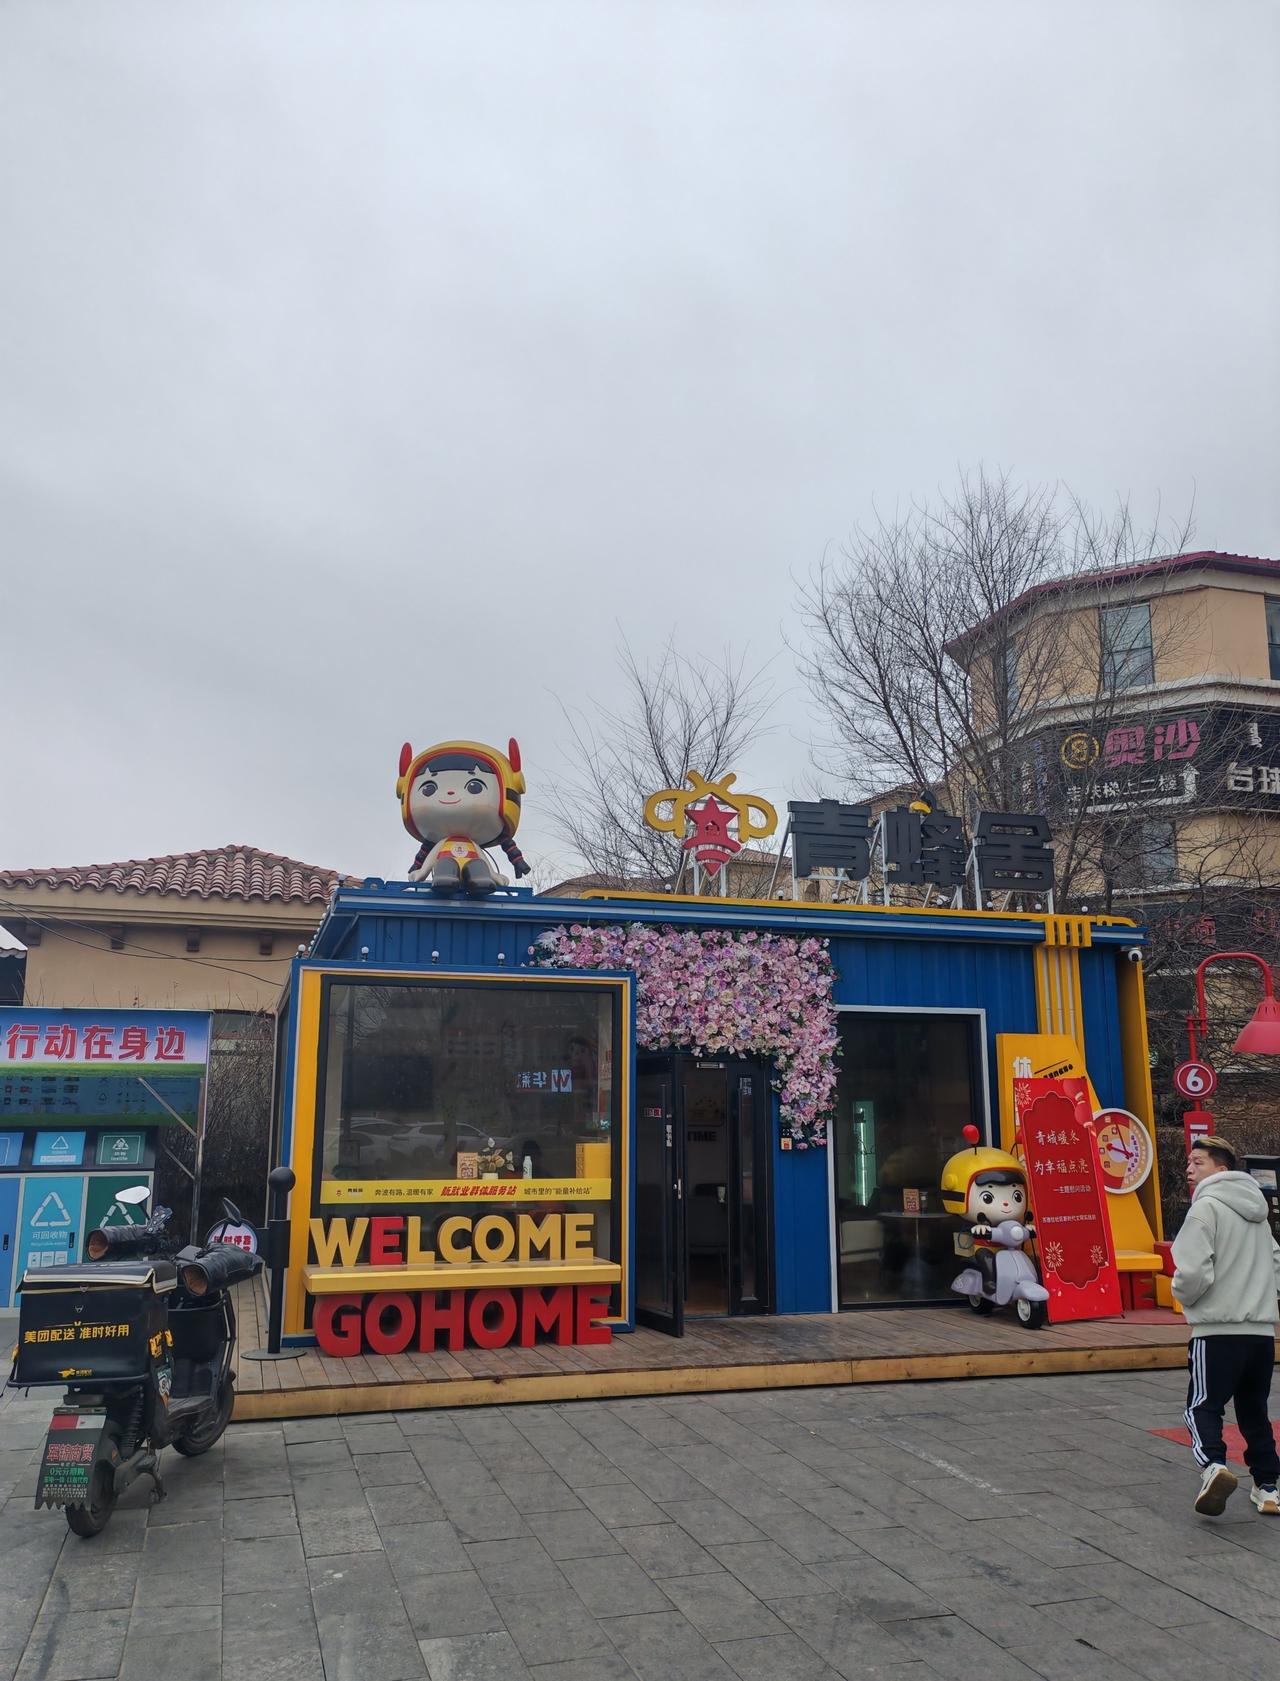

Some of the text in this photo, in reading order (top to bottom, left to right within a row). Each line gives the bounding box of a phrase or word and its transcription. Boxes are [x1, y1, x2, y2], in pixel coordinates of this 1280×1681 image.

[6, 1024, 187, 1061] 行动在身边
[1186, 1068, 1204, 1092] 6
[1036, 1130, 1080, 1146] 青城暖冬
[1034, 1159, 1090, 1176] 为幸福点亮
[309, 1213, 595, 1267] WELCOME
[23, 1324, 129, 1343] 美团配送 准时好用
